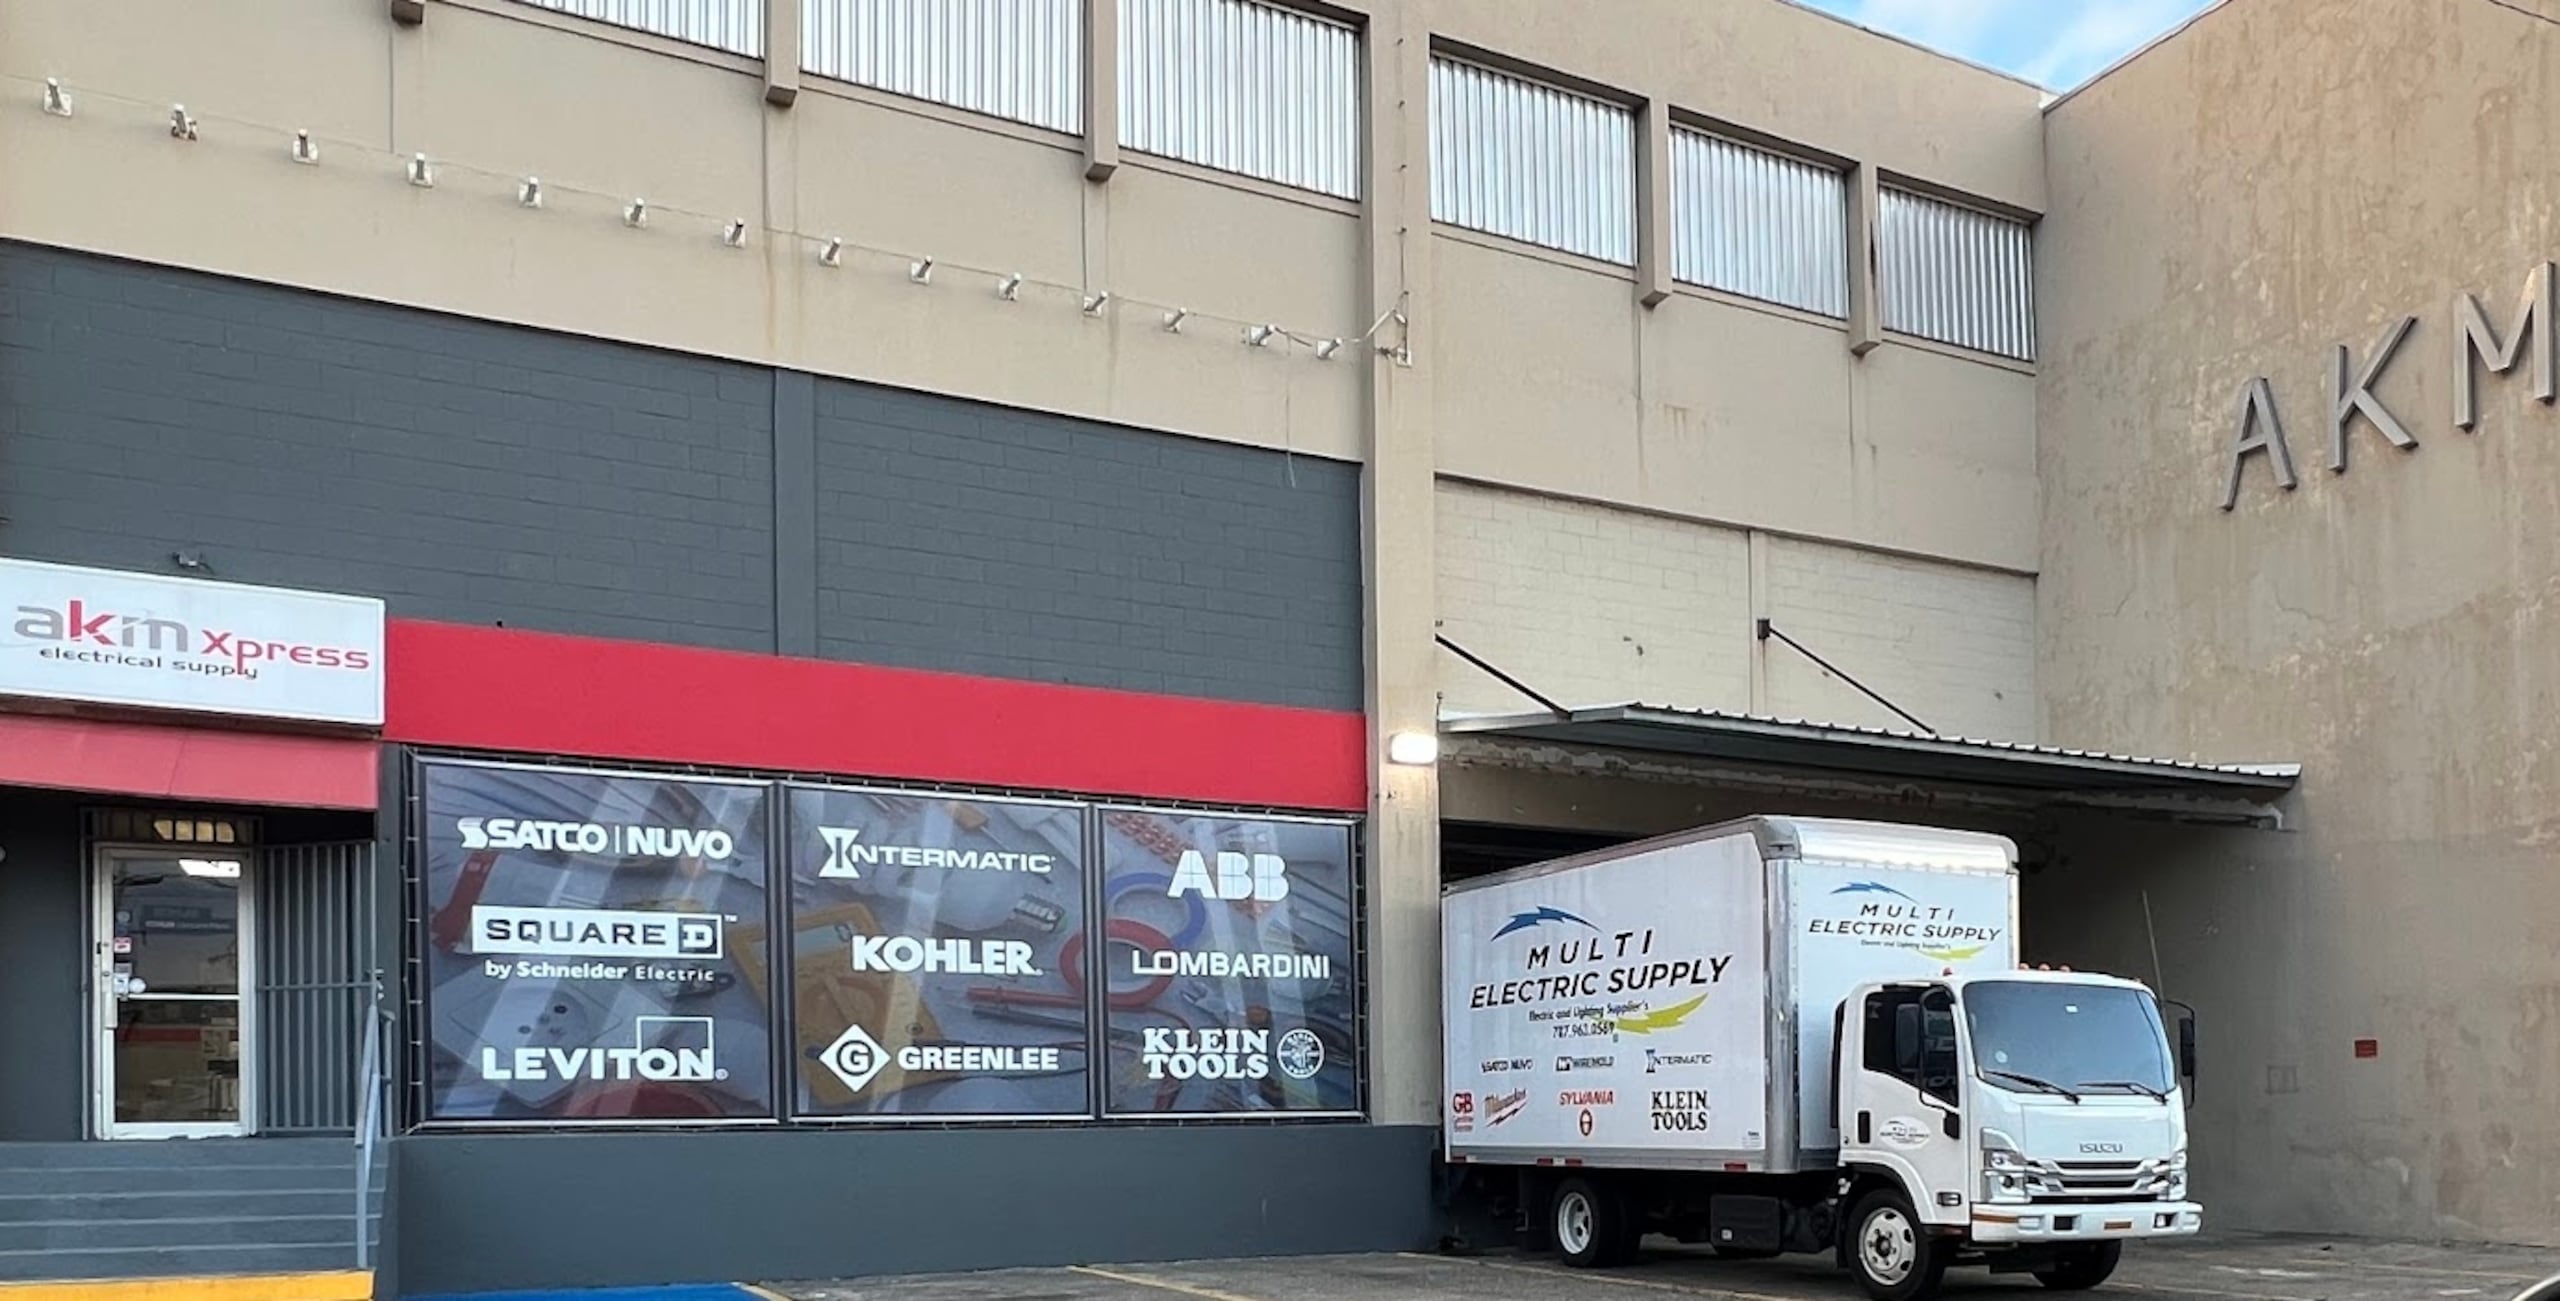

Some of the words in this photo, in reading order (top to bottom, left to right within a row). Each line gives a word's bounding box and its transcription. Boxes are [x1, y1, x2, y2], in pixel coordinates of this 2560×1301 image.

[2221, 261, 2556, 511] AKM
[14, 600, 188, 652] akm
[40, 647, 161, 669] electrical
[173, 661, 257, 679] supply
[487, 819, 608, 852] SATCO
[627, 827, 733, 860] NUVO
[818, 826, 1055, 879] INTERMATIC
[1167, 850, 1290, 901] ABB
[1860, 903, 1955, 921] MULTI
[486, 918, 667, 946] SQUARE
[1809, 919, 1917, 937] ELECTRIC
[1923, 924, 2001, 942] SUPPLY
[852, 935, 1043, 976] KOHLER
[1527, 929, 1653, 969] MULTI
[485, 960, 511, 978] by
[516, 961, 628, 980] Schneider
[634, 966, 714, 982] Electric
[1132, 950, 1330, 978] LOMBARDINI
[1470, 972, 1600, 1009] ELECTRIC
[1607, 954, 1734, 994] SUPPLY
[1143, 1028, 1269, 1053] KLEIN
[898, 1047, 1059, 1071] GREENLEE
[1143, 1054, 1269, 1079] TOOLS
[1560, 1091, 1613, 1105] SYLVANIA
[1652, 1090, 1708, 1109] KLEIN
[1652, 1111, 1708, 1131] TOOLS
[2080, 1143, 2123, 1153] ISUZU
